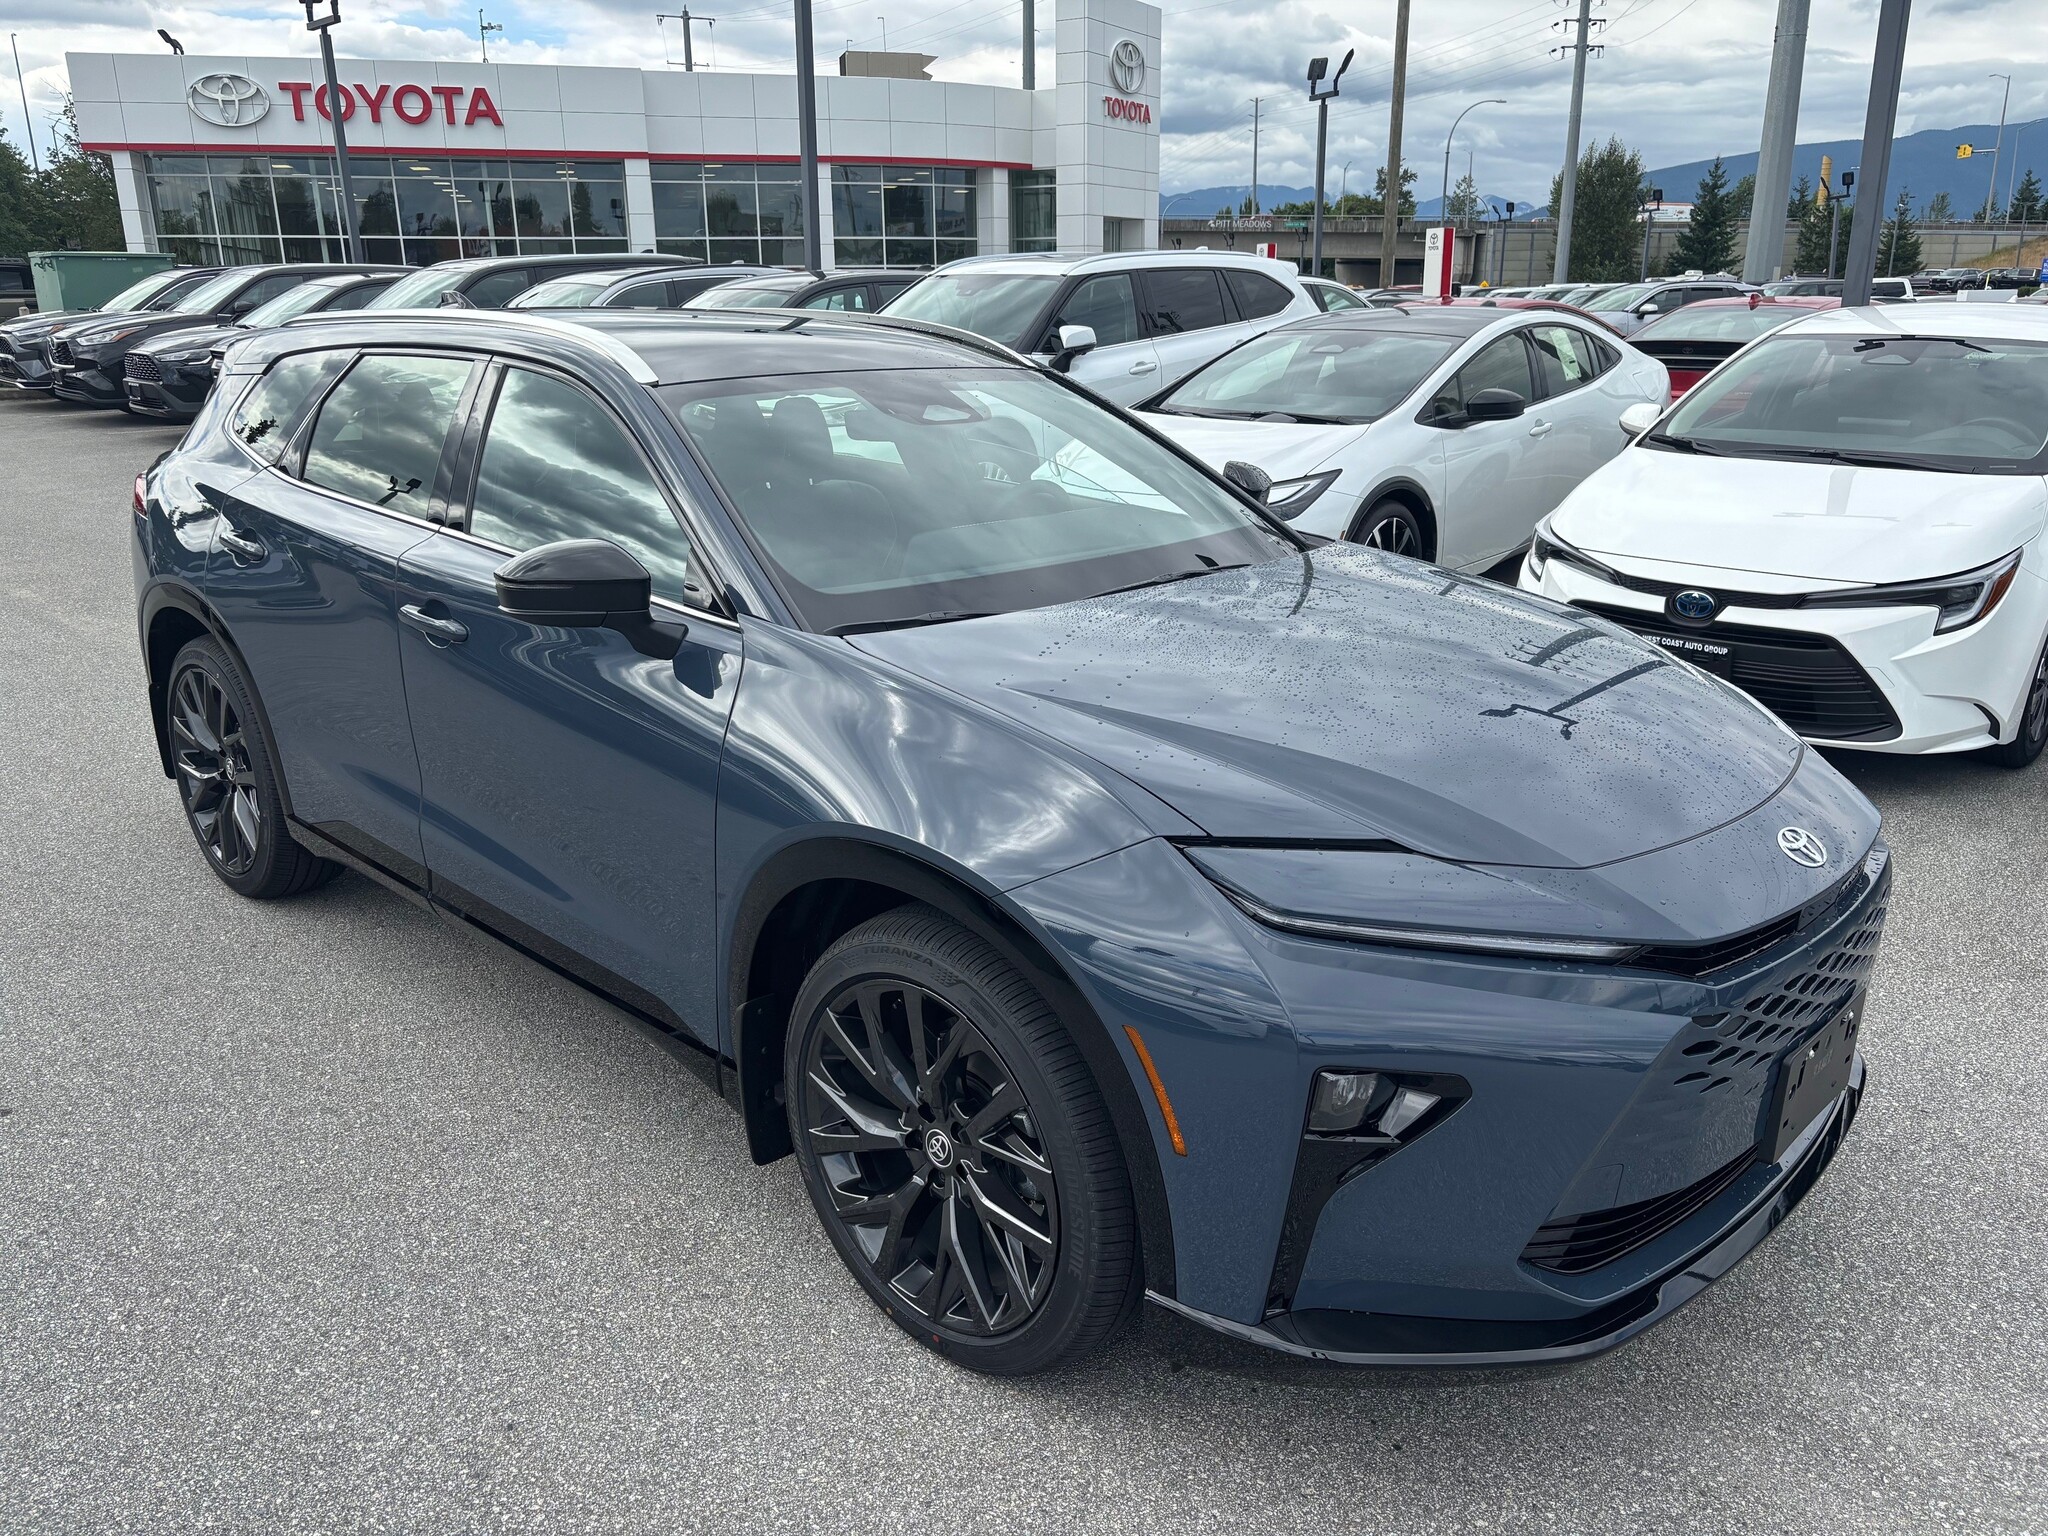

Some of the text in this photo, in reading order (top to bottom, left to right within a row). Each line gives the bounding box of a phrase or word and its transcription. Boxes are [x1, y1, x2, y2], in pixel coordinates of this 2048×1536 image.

[278, 82, 504, 126] TOYOTA
[1103, 96, 1151, 123] TOYOTA
[1216, 220, 1272, 228] PITT MEADOWS
[1661, 637, 1684, 648] COAST
[1684, 641, 1703, 651] AUTO
[1704, 644, 1728, 655] GROUP
[863, 945, 933, 967] TURANZA
